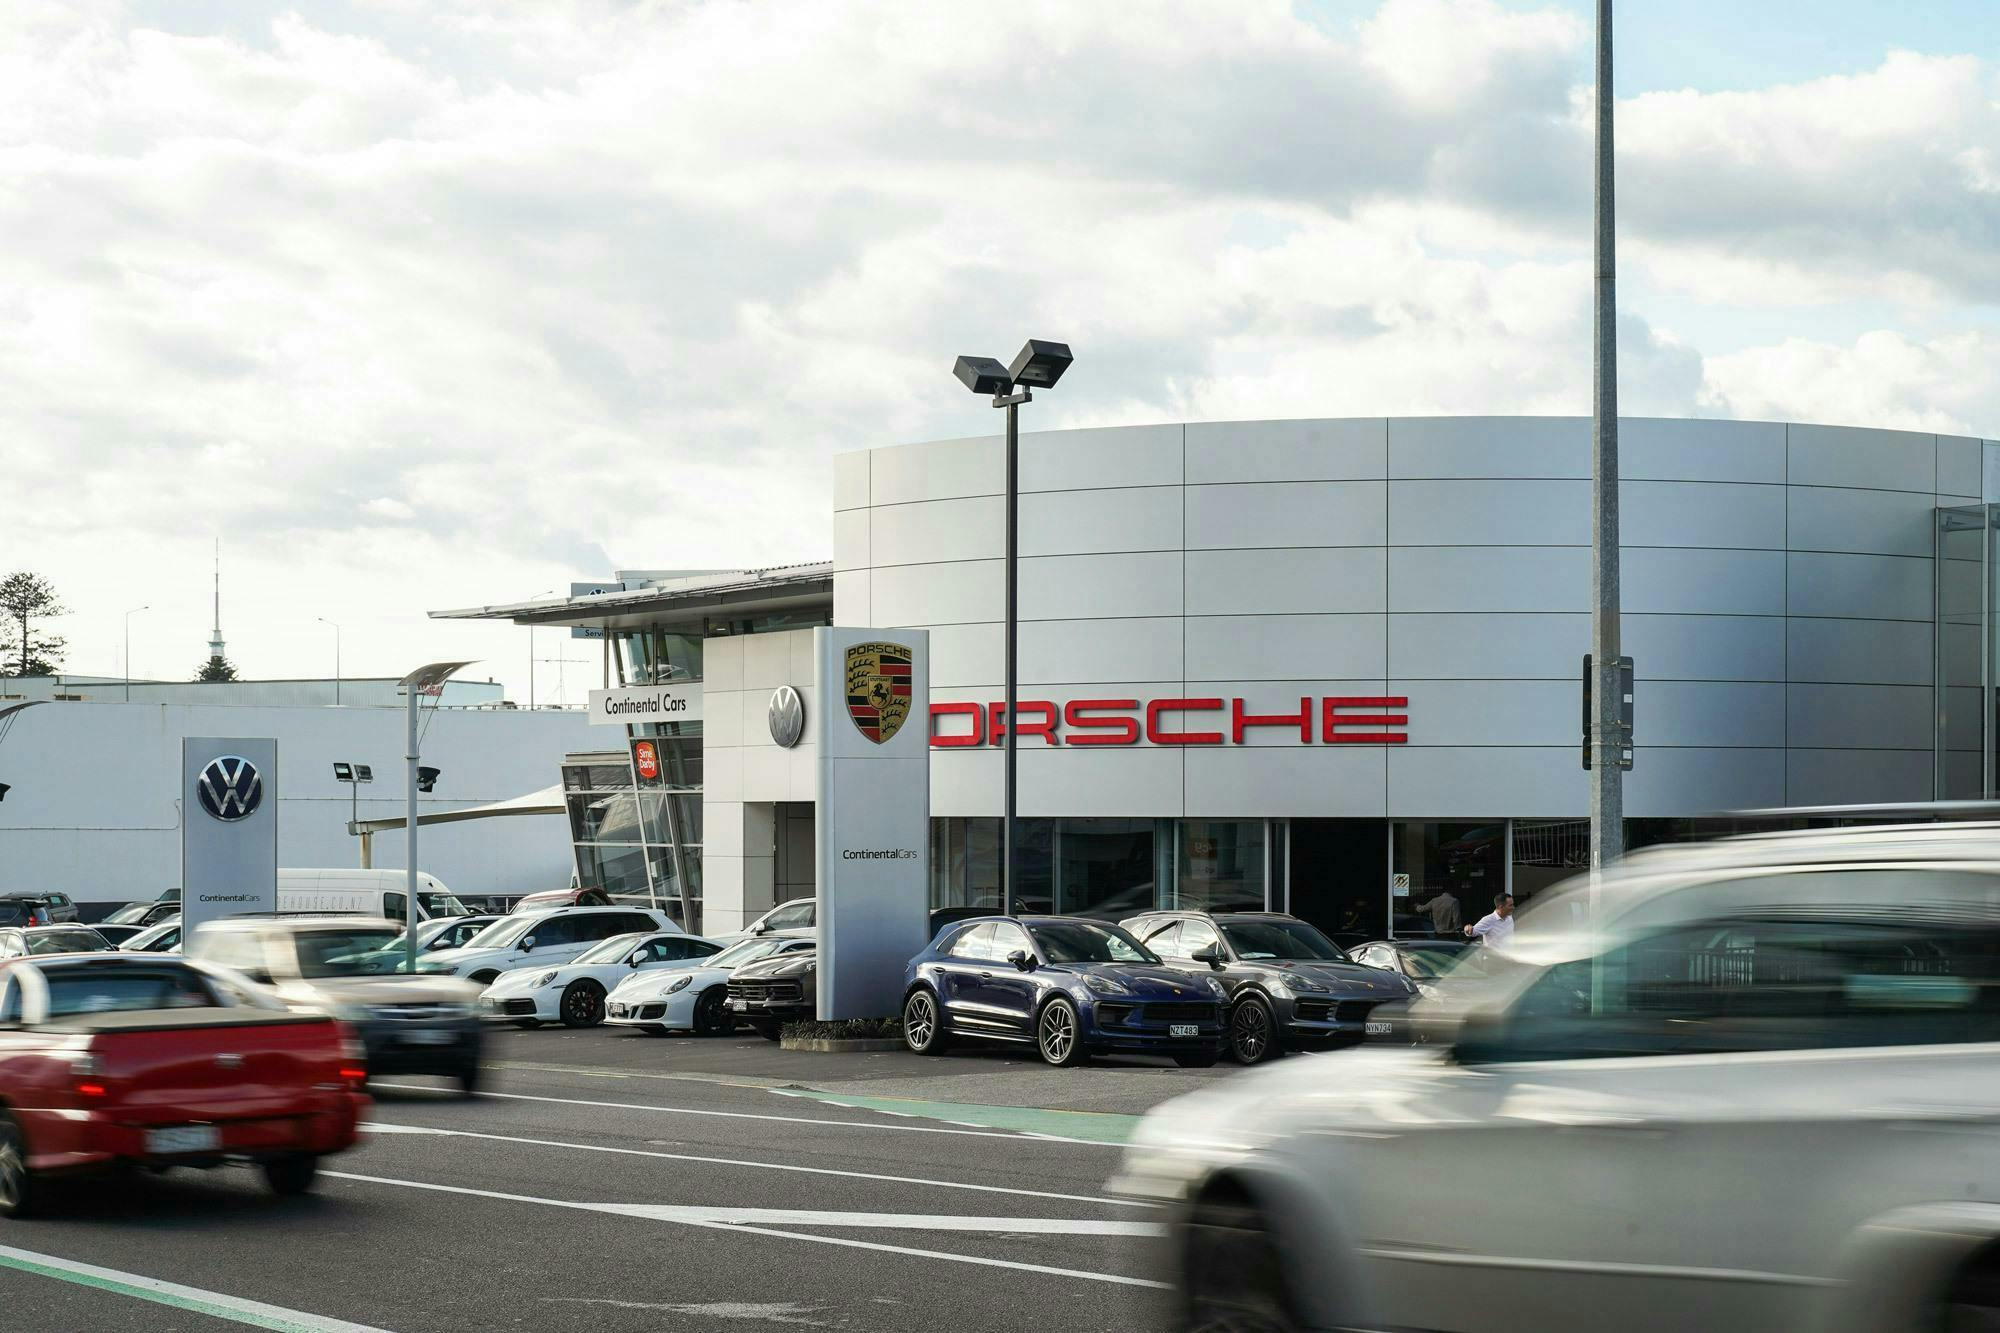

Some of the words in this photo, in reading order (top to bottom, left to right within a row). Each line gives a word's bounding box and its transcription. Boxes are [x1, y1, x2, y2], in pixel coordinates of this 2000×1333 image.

[848, 644, 911, 658] PORSCHE
[605, 693, 660, 714] Continental
[663, 693, 686, 712] Cars
[929, 696, 1408, 747] ORSCHE
[639, 748, 653, 758] Sime
[640, 759, 655, 771] Darby
[842, 848, 918, 860] ContinentalCars
[199, 893, 261, 902] ContinentalCars
[276, 895, 364, 910] EHOUSE.CO.NZ
[1170, 1026, 1198, 1035] NZT483
